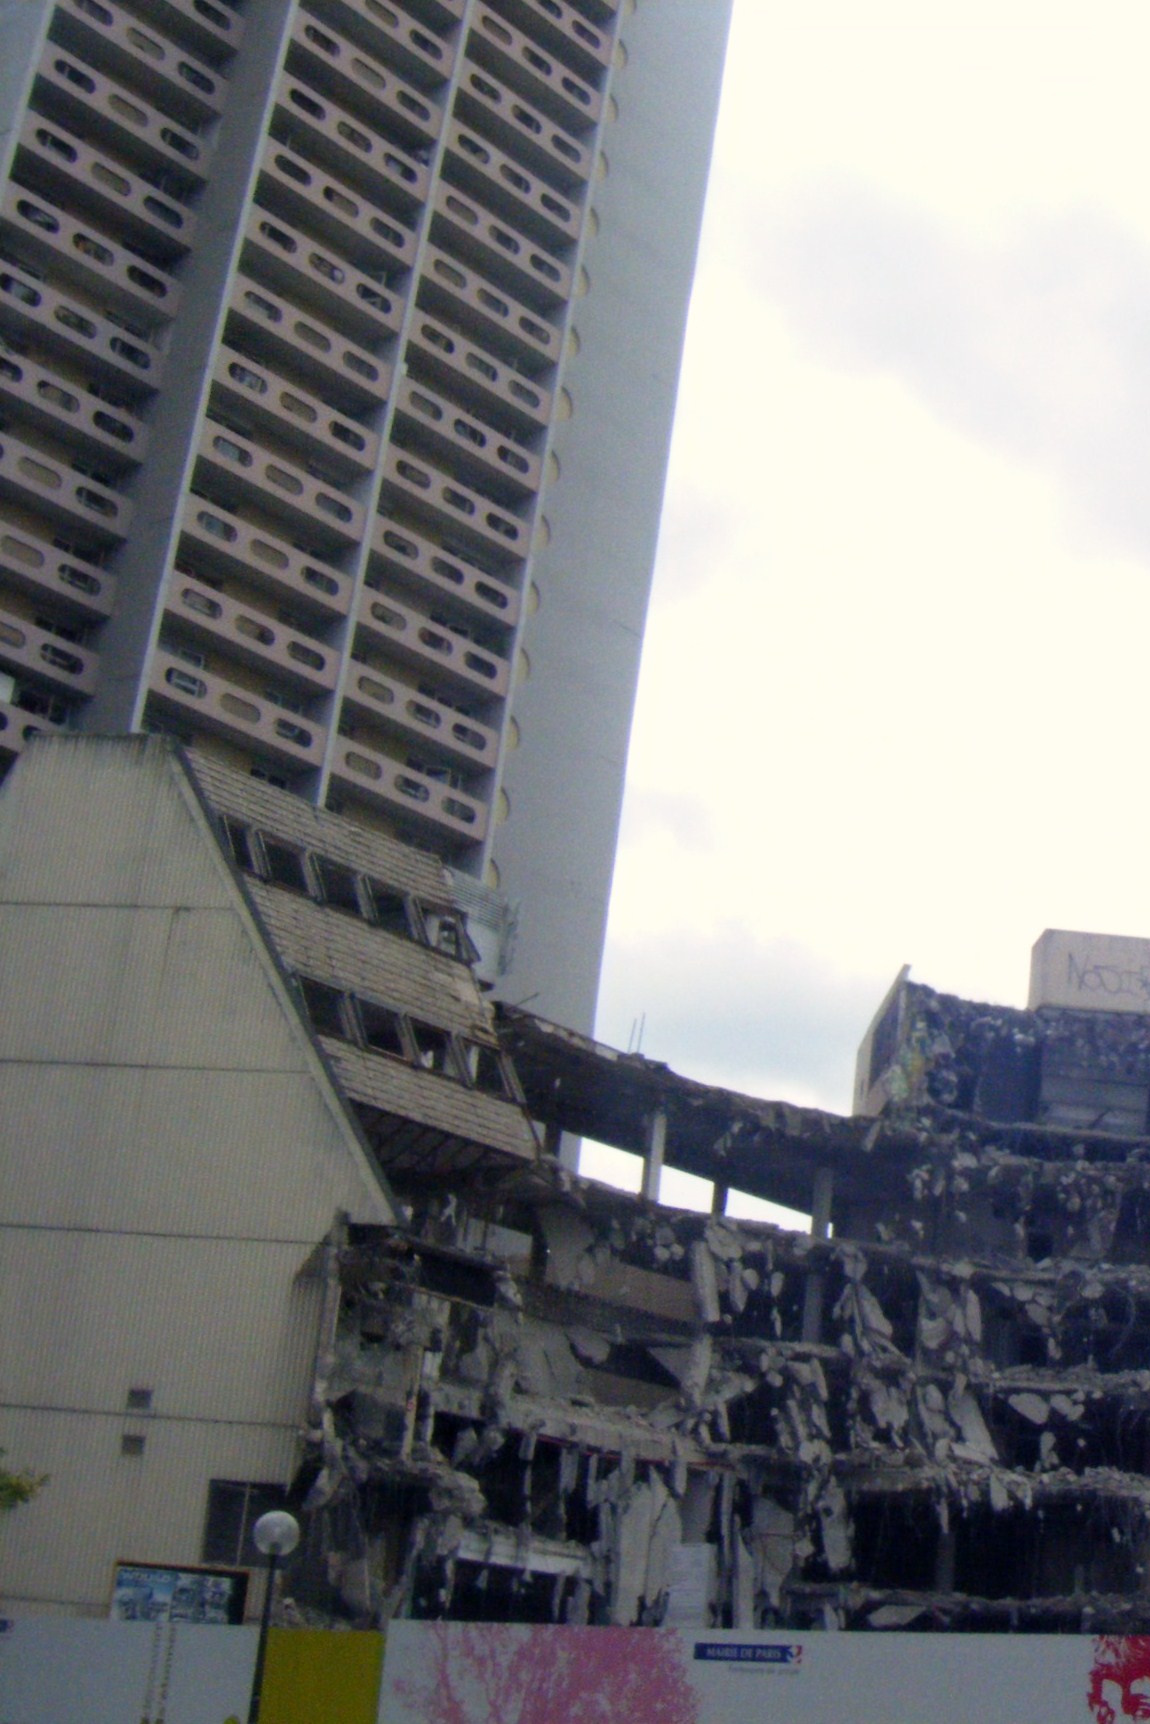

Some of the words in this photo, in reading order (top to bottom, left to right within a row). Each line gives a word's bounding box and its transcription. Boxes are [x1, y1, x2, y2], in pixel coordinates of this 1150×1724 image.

[706, 1647, 738, 1658] MAIRIE
[740, 1648, 753, 1659] DE
[755, 1648, 781, 1659] PARIS
